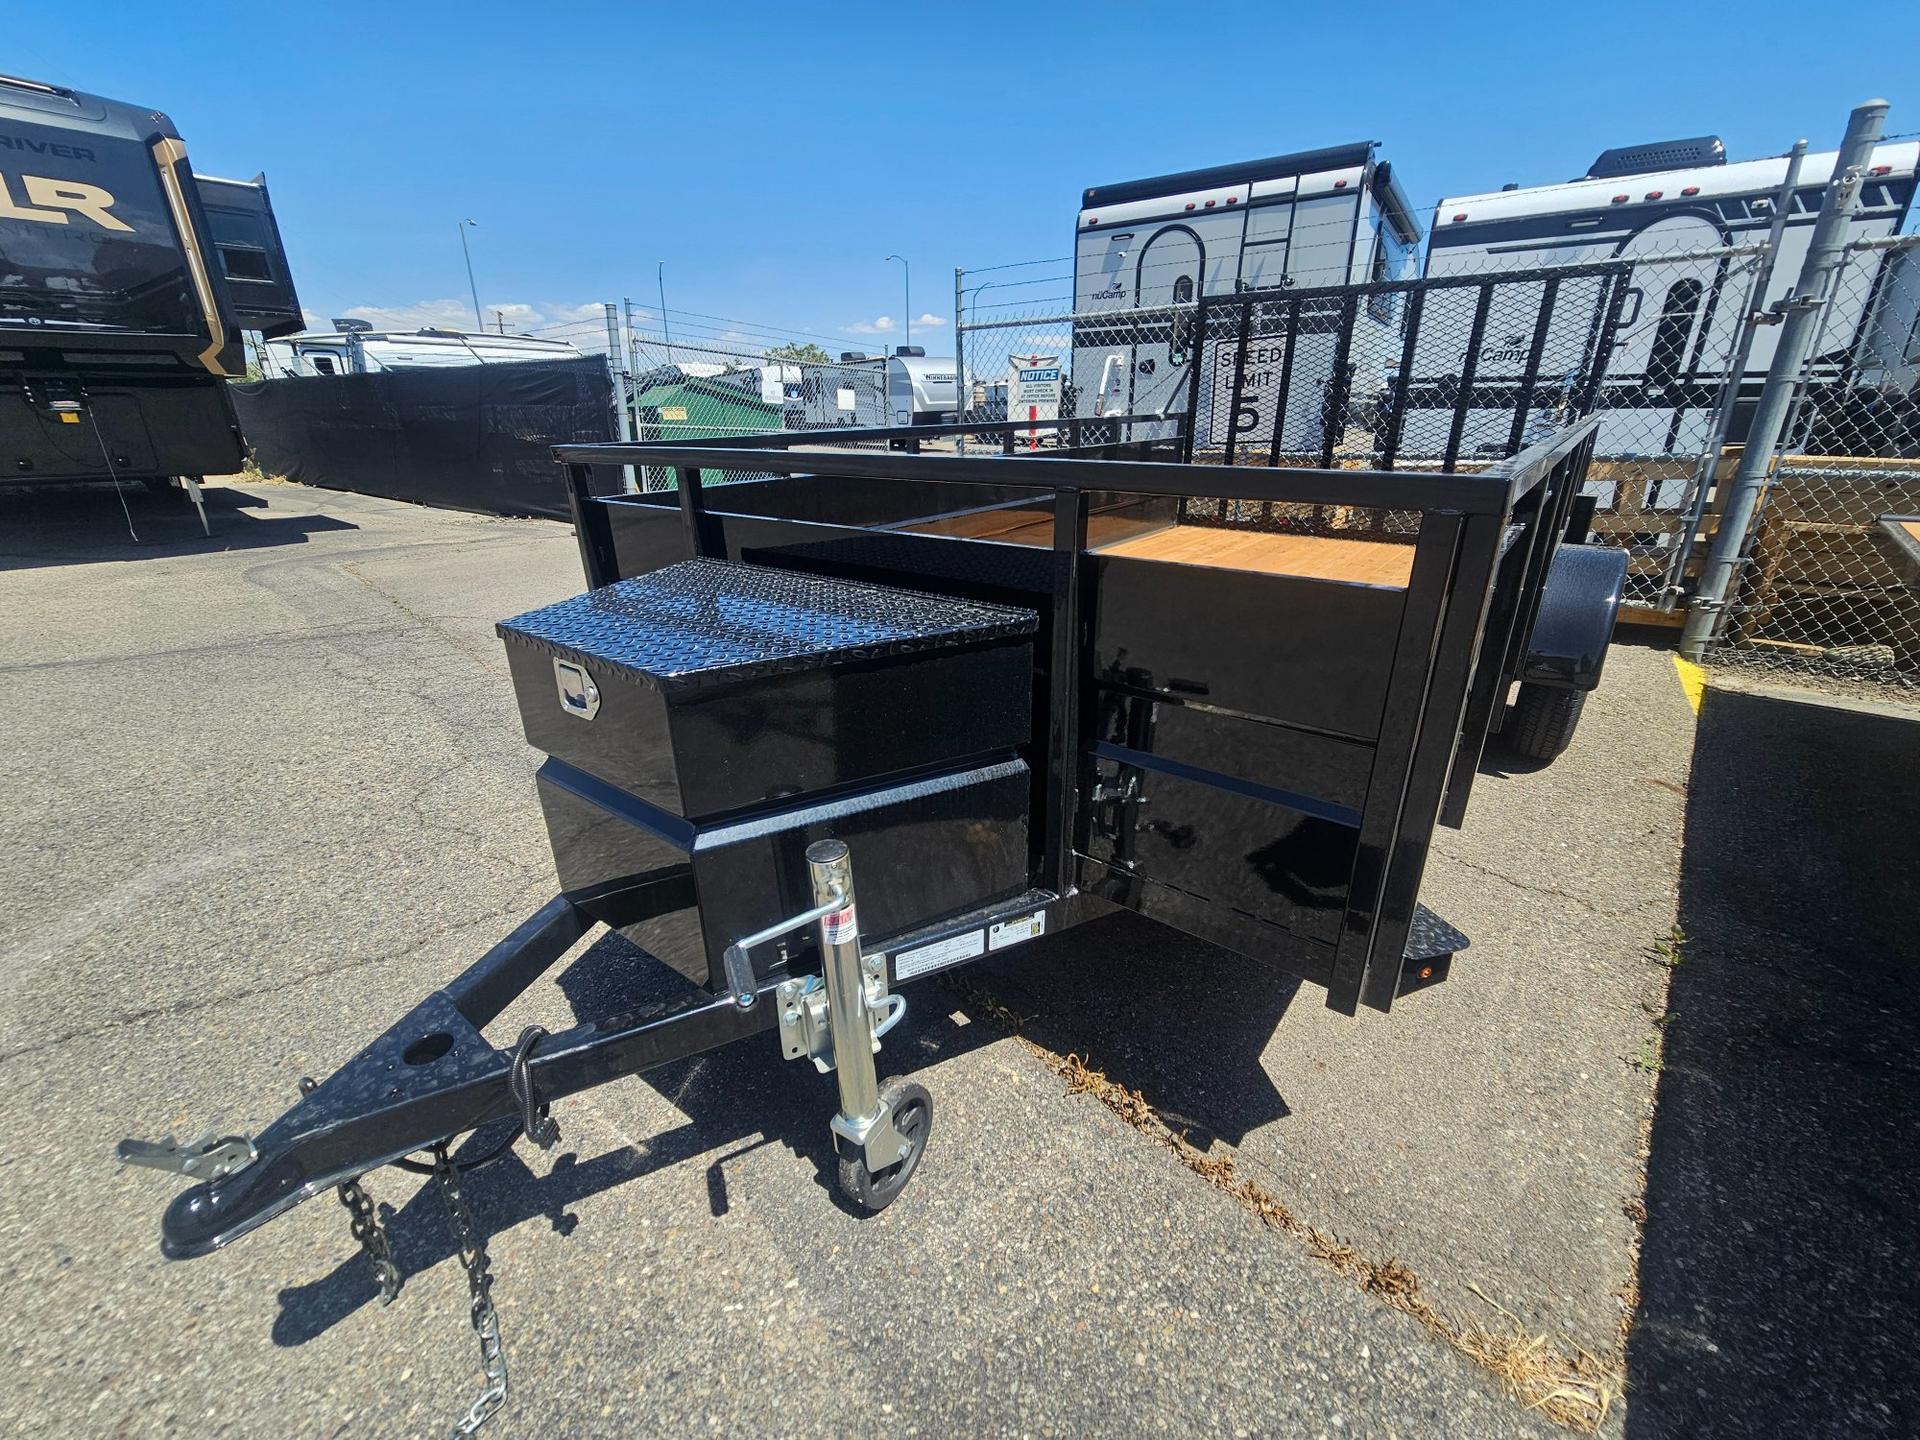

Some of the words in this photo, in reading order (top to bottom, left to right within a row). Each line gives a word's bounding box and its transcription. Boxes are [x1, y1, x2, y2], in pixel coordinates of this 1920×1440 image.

[1092, 290, 1126, 300] nüCamp
[1020, 370, 1058, 381] NOTICE
[1226, 372, 1273, 389] LMIT
[1235, 396, 1259, 432] 5
